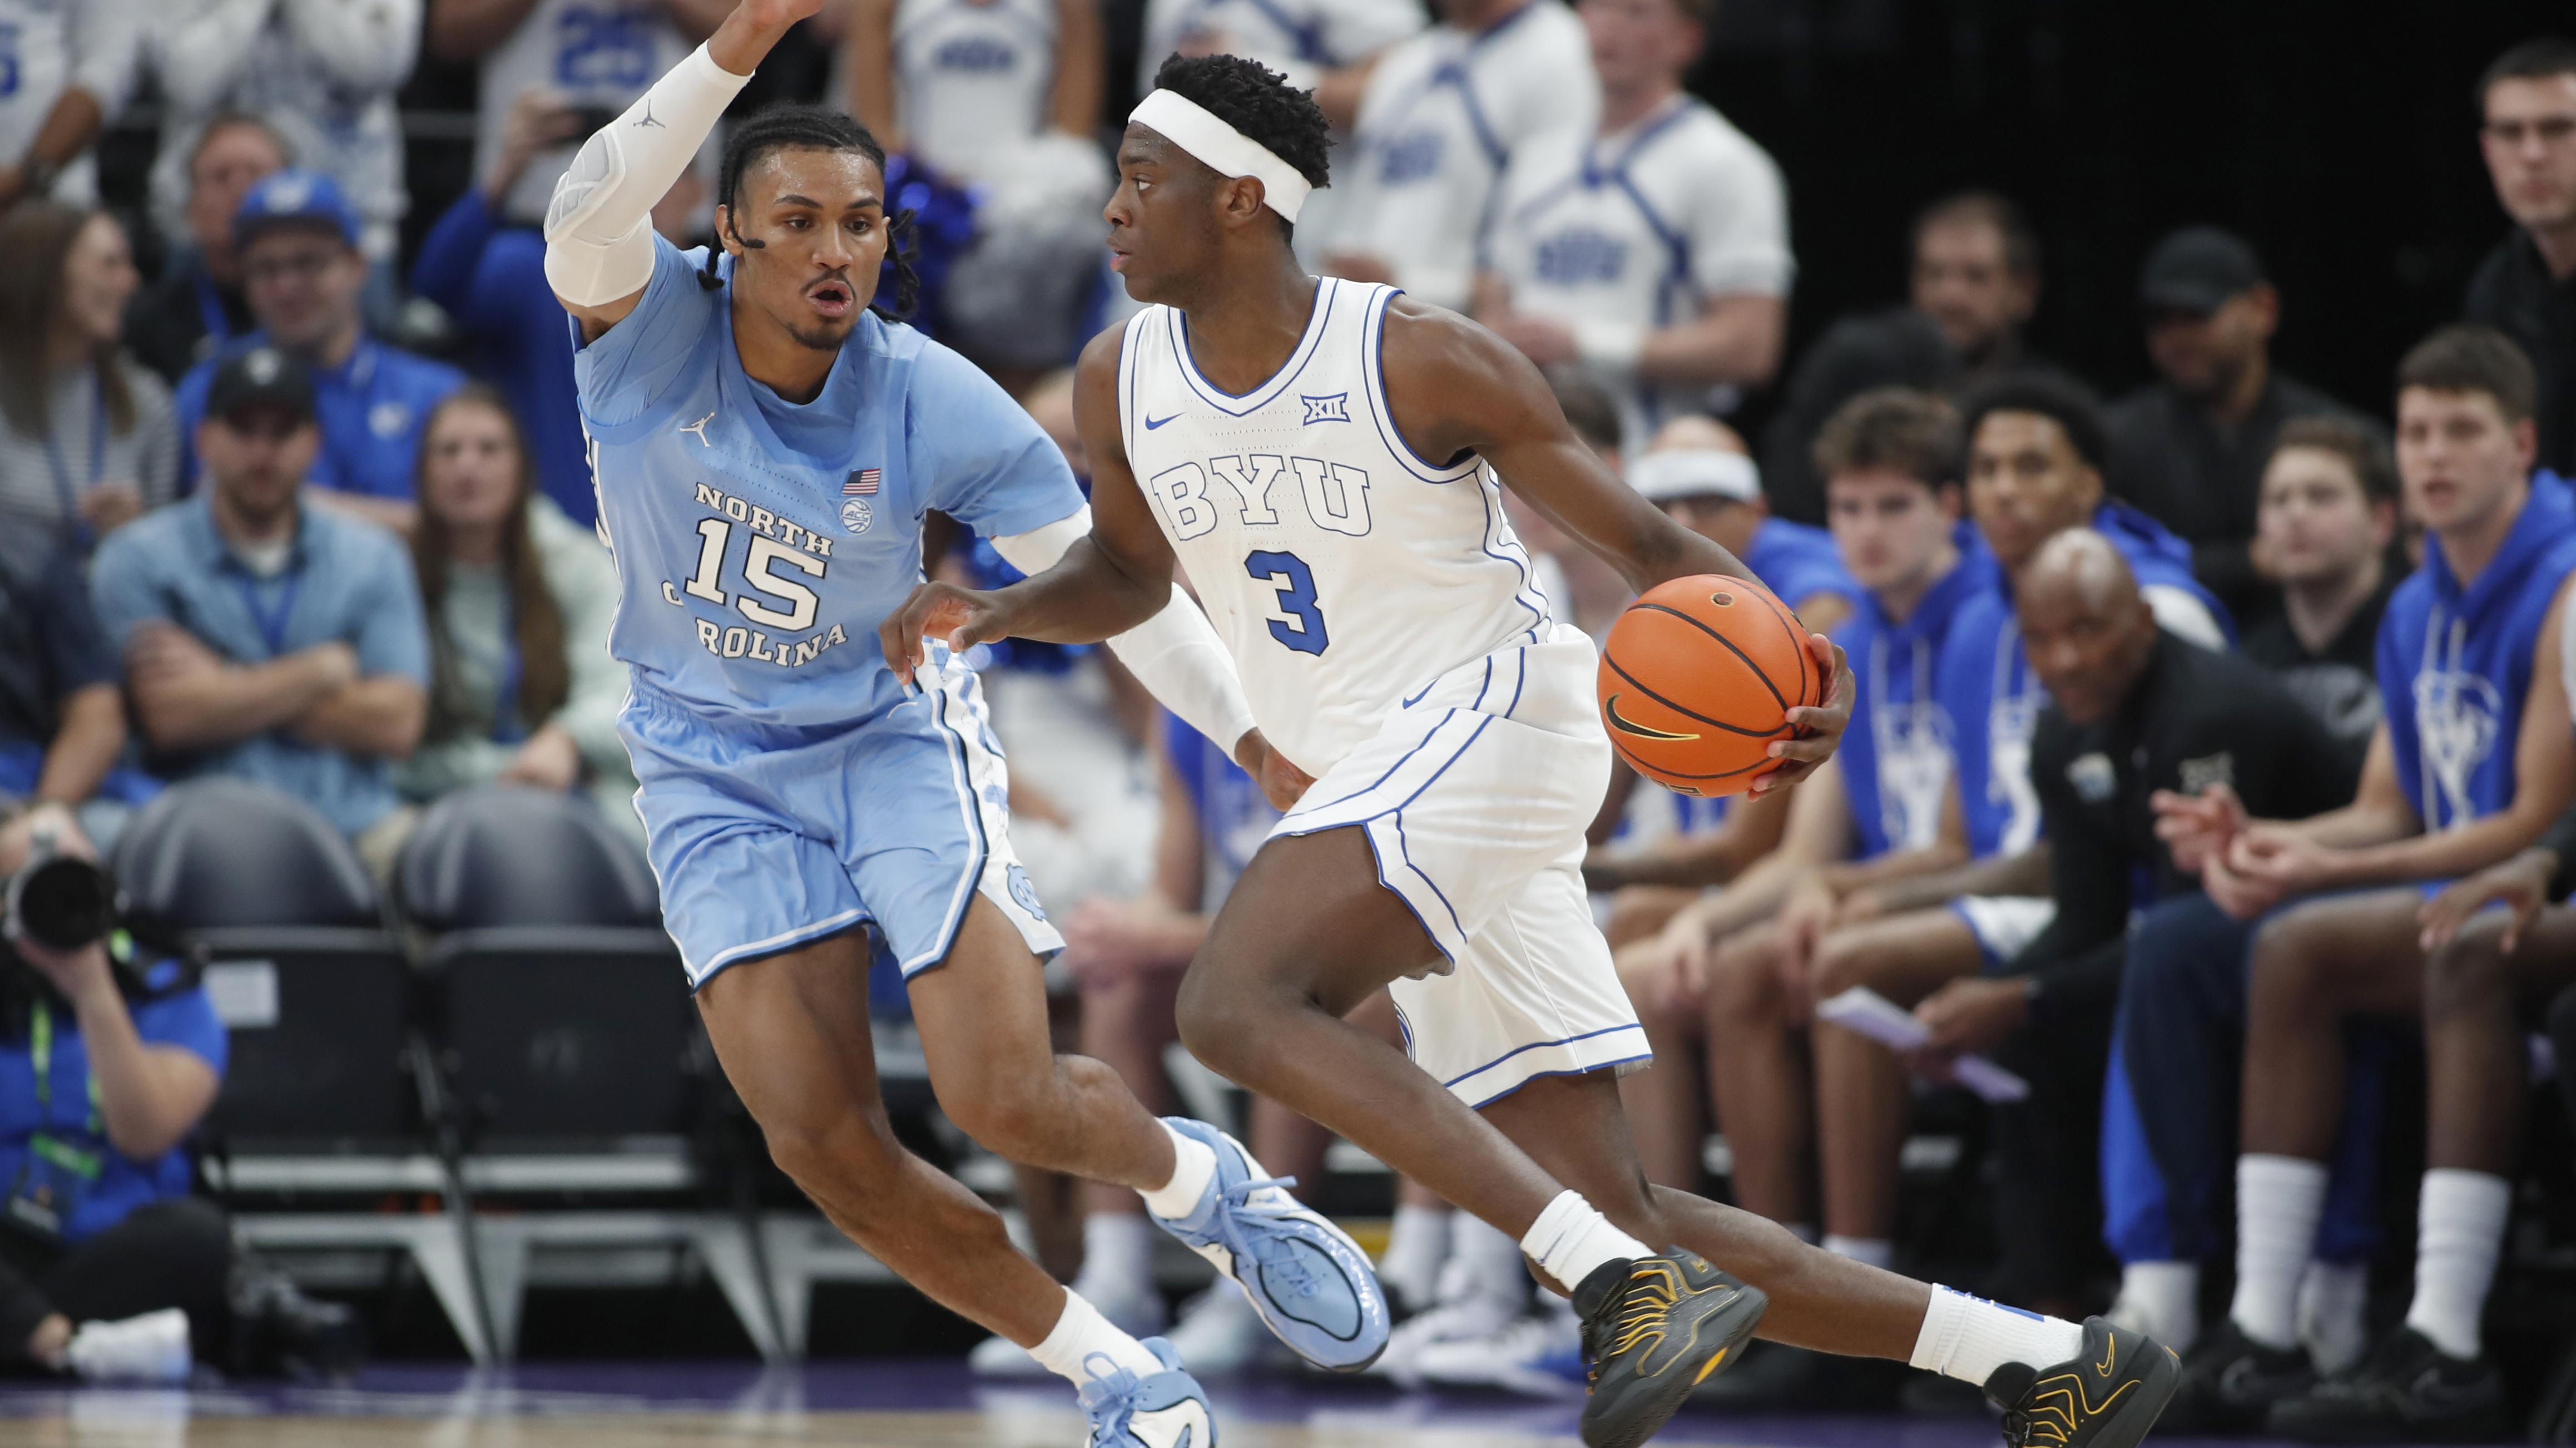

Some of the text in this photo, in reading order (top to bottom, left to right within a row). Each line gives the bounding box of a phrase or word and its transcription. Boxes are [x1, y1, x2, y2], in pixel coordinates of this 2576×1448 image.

[1300, 392, 1351, 426] XII
[695, 482, 833, 556] NORTH
[844, 510, 872, 522] ACC
[1150, 454, 1371, 541] BYU
[685, 517, 828, 632] 15
[1244, 549, 1330, 658] 3
[661, 580, 848, 668] CROLINA
